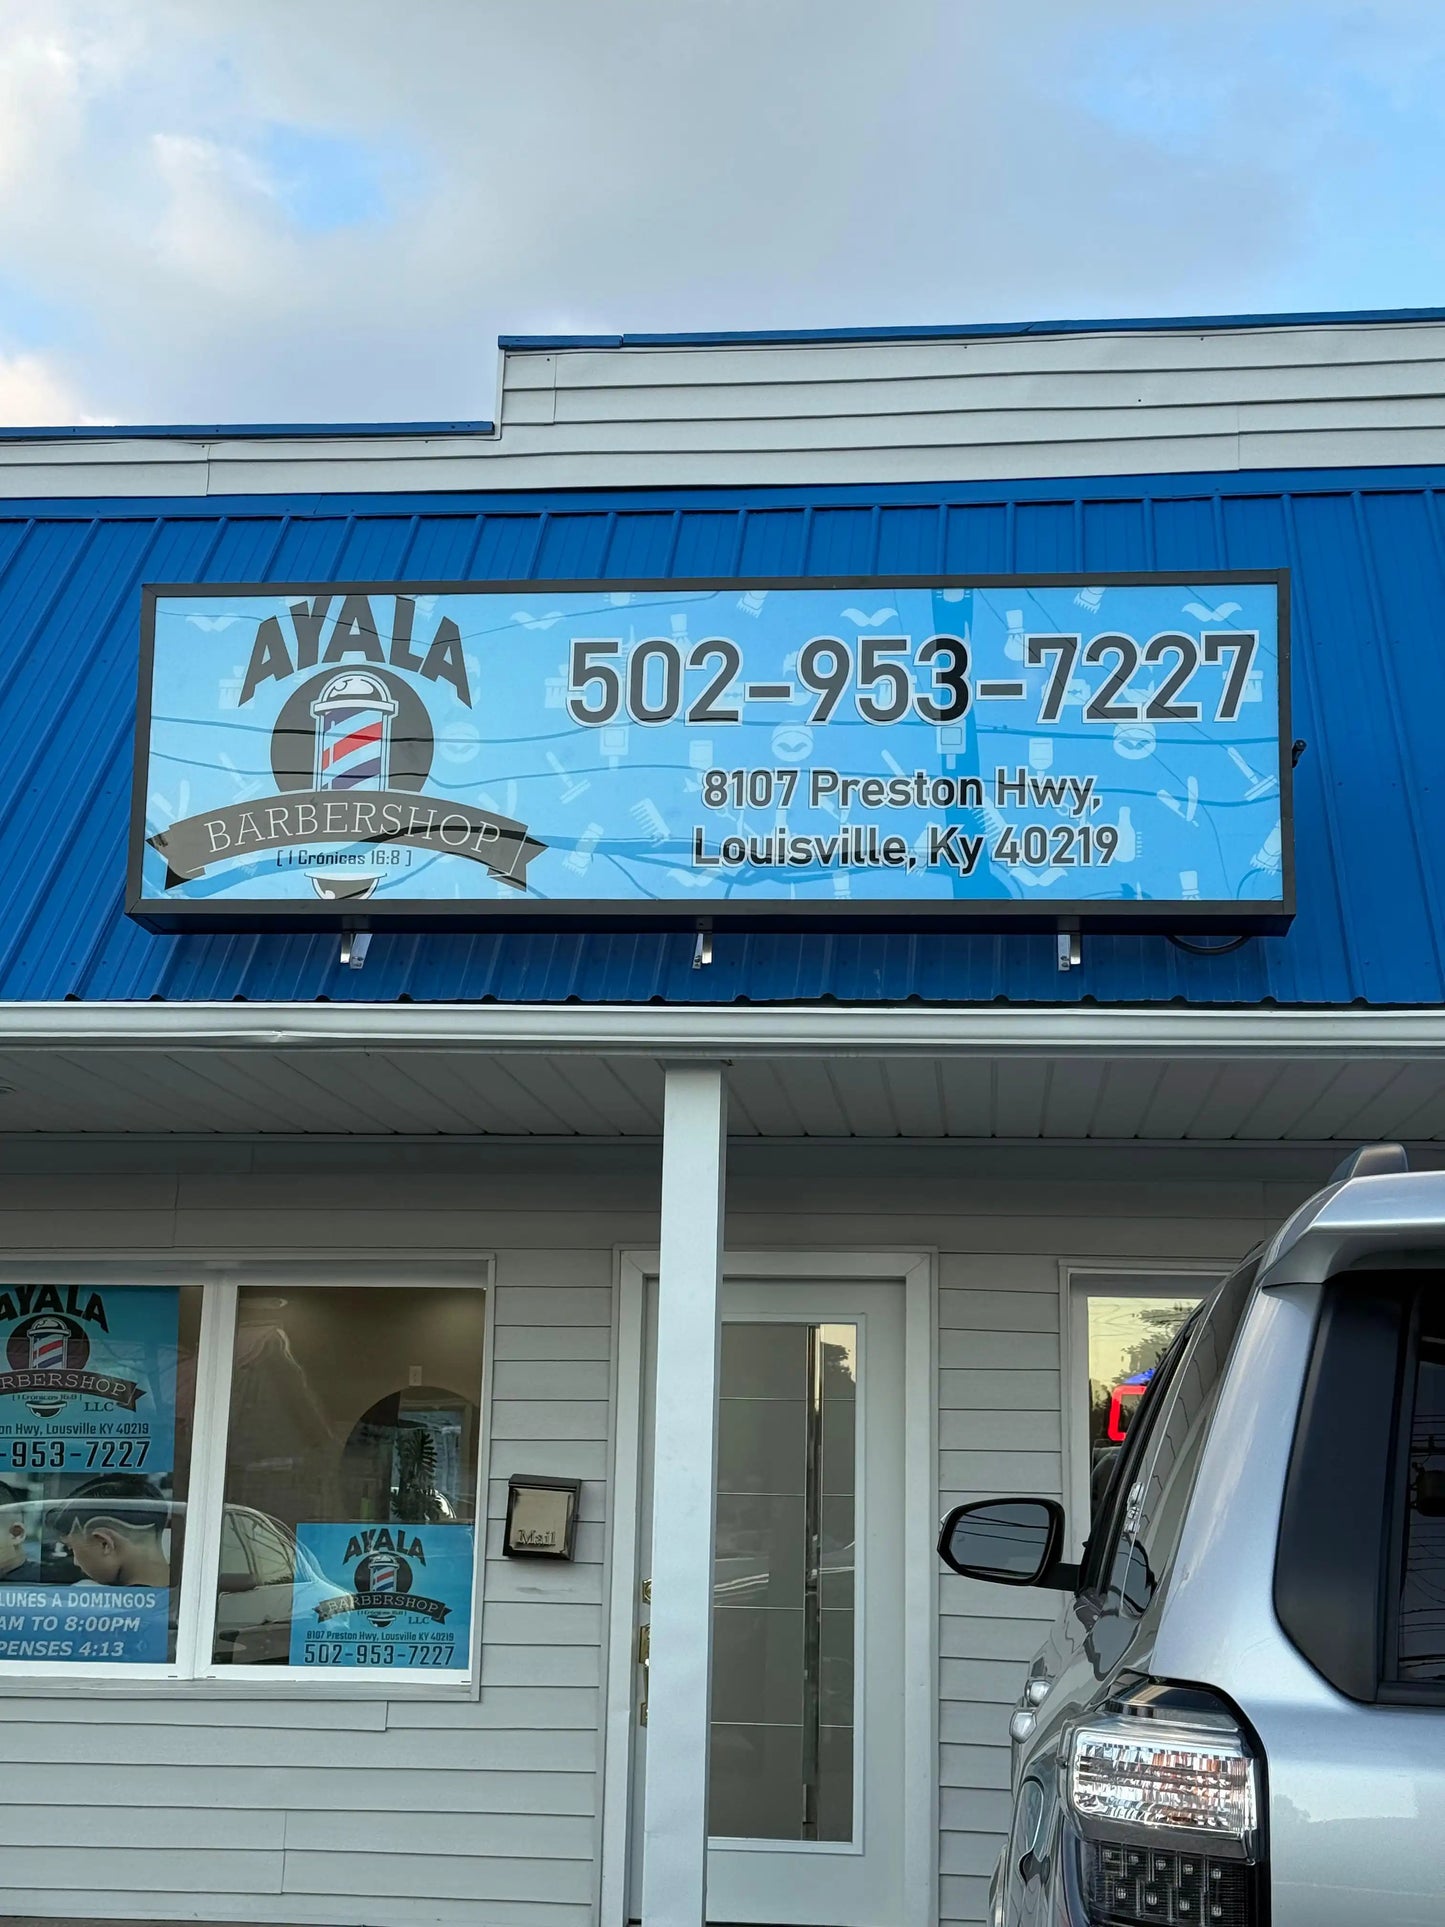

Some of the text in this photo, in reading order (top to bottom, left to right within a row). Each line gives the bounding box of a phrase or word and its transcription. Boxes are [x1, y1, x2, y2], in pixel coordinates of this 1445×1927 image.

[238, 595, 472, 709] AYALA
[566, 632, 1259, 726] 502-953-7227
[704, 768, 1101, 815] 8107 Preston Hwy,
[204, 803, 500, 855] BARBERSHOP
[298, 850, 365, 864] Crónicas
[371, 850, 400, 864] 16:8
[692, 824, 1118, 876] Louisville, Ky 40219
[84, 1402, 114, 1412] LLC
[15, 1423, 42, 1436] Hwy,
[99, 1423, 114, 1435] KY
[116, 1423, 149, 1435] 40219
[518, 1529, 556, 1545] Mail
[343, 1528, 426, 1567] AYALA
[0, 1592, 156, 1608] LUNES A DOMINGOS
[327, 1595, 439, 1612] BARBERSHOP
[31, 1615, 58, 1631] TO
[64, 1615, 141, 1632] 8:00PM
[408, 1616, 430, 1625] LLC
[327, 1631, 357, 1641] Preston
[419, 1632, 430, 1641] KY
[78, 1641, 125, 1657] 4:13
[304, 1643, 455, 1666] 502-953-7227
